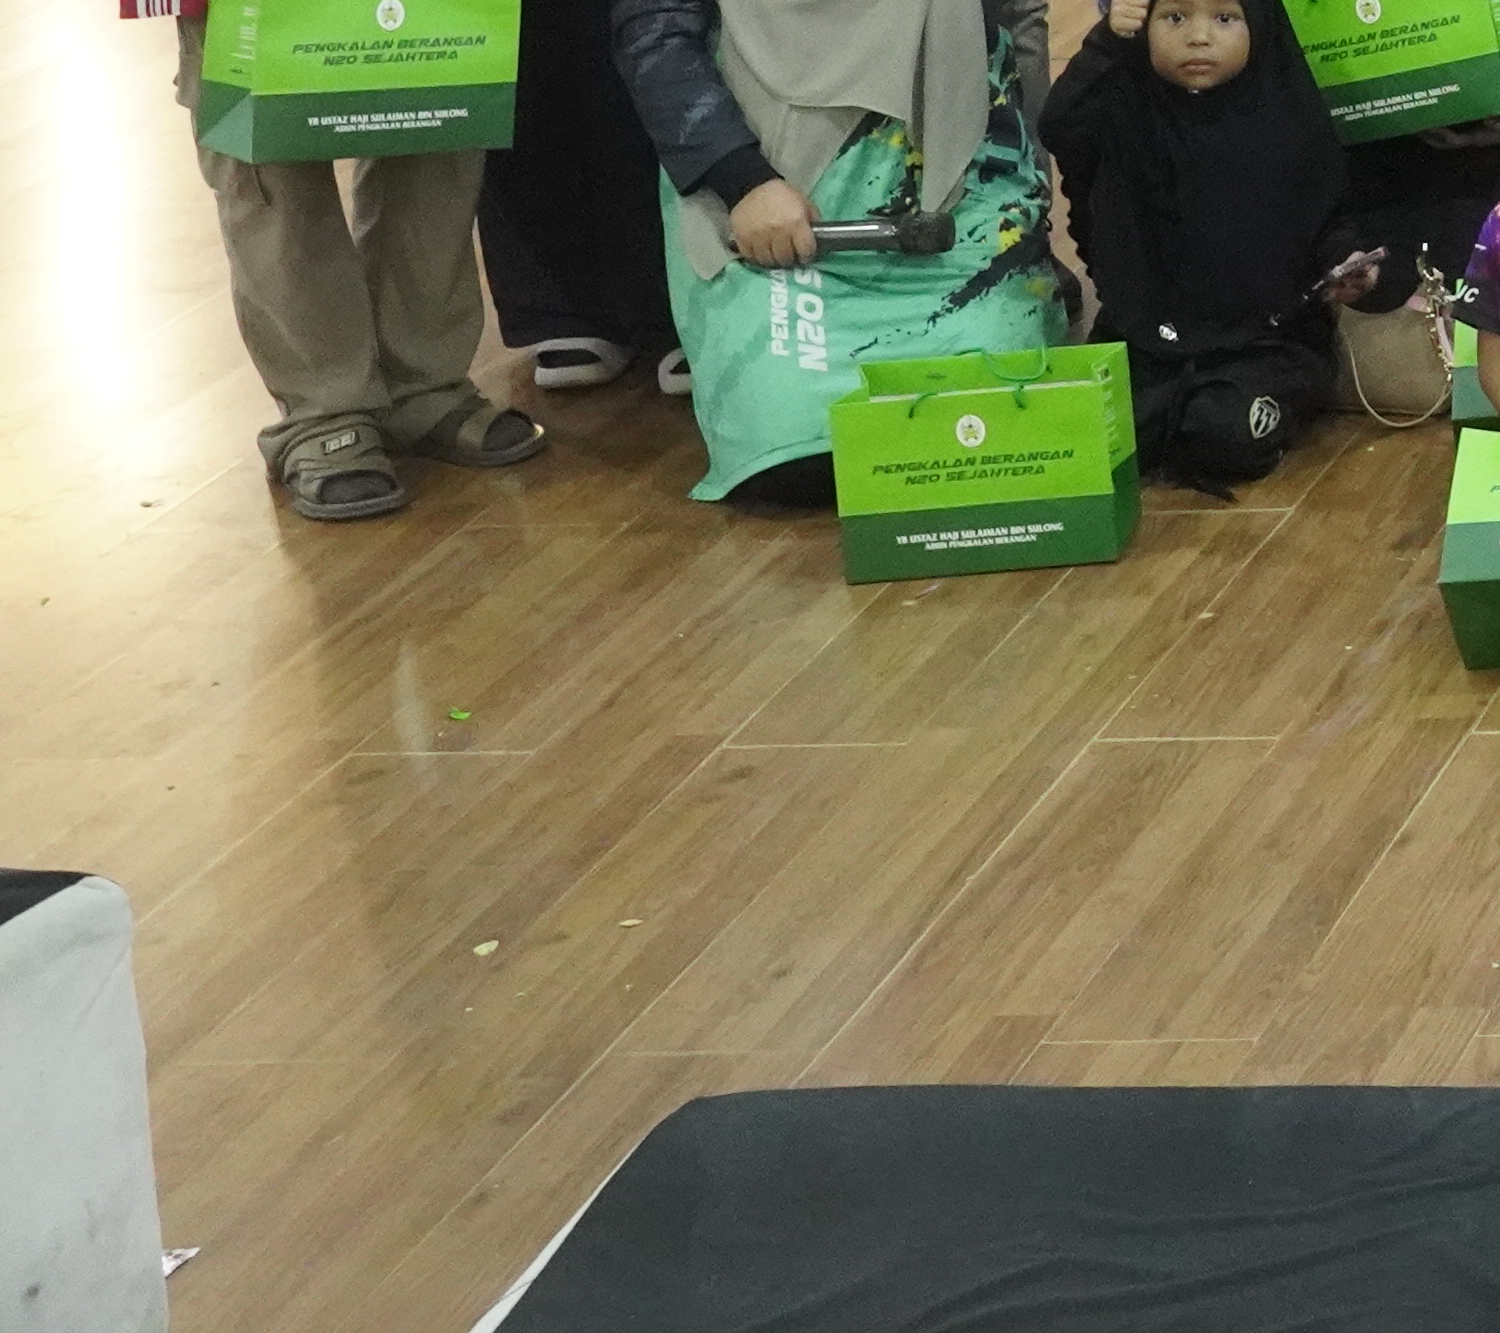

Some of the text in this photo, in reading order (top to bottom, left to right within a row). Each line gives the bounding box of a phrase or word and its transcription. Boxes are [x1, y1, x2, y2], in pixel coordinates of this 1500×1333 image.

[291, 34, 486, 54] PENGKALAN BERANGAN
[360, 49, 458, 64] SEJAHTERA
[871, 448, 1074, 475] PENGKALAN BERANGAN
[944, 464, 1045, 482] SEJAHTERA
